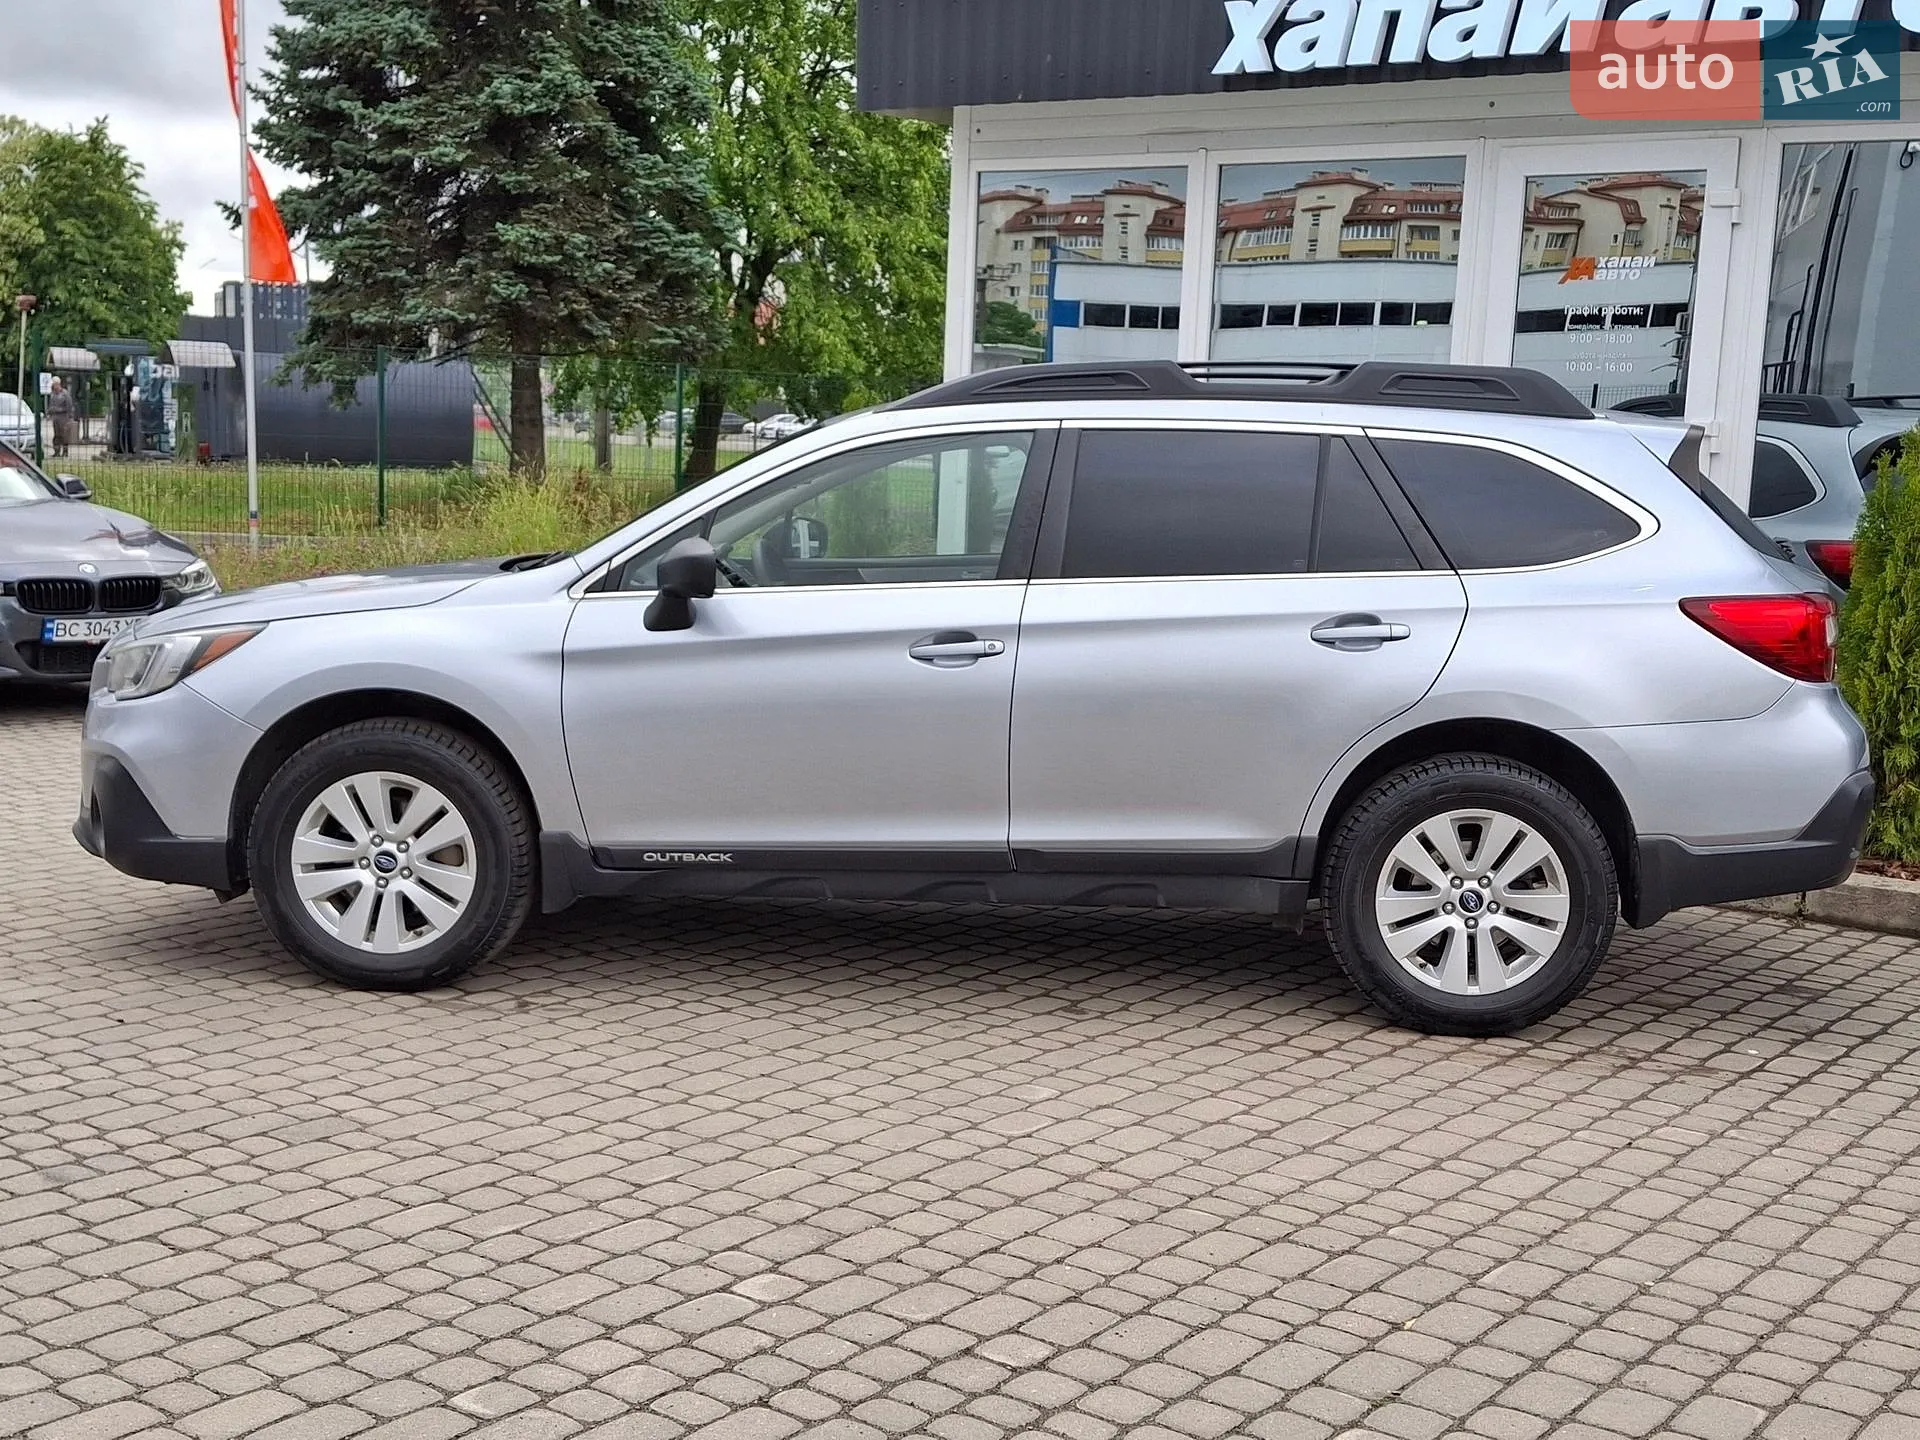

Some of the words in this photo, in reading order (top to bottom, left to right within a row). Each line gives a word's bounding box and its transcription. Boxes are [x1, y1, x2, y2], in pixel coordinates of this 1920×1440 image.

[1596, 268, 1641, 280] авто
[1565, 305, 1599, 317] Графік
[1601, 305, 1644, 317] роботи:
[1570, 333, 1593, 343] 9:00
[1605, 333, 1633, 343] 18:00
[1566, 361, 1593, 372] 10:00
[1605, 361, 1633, 372] 16:00
[55, 622, 80, 637] BC
[83, 620, 121, 637] 3043
[643, 852, 734, 863] OUTBACK
